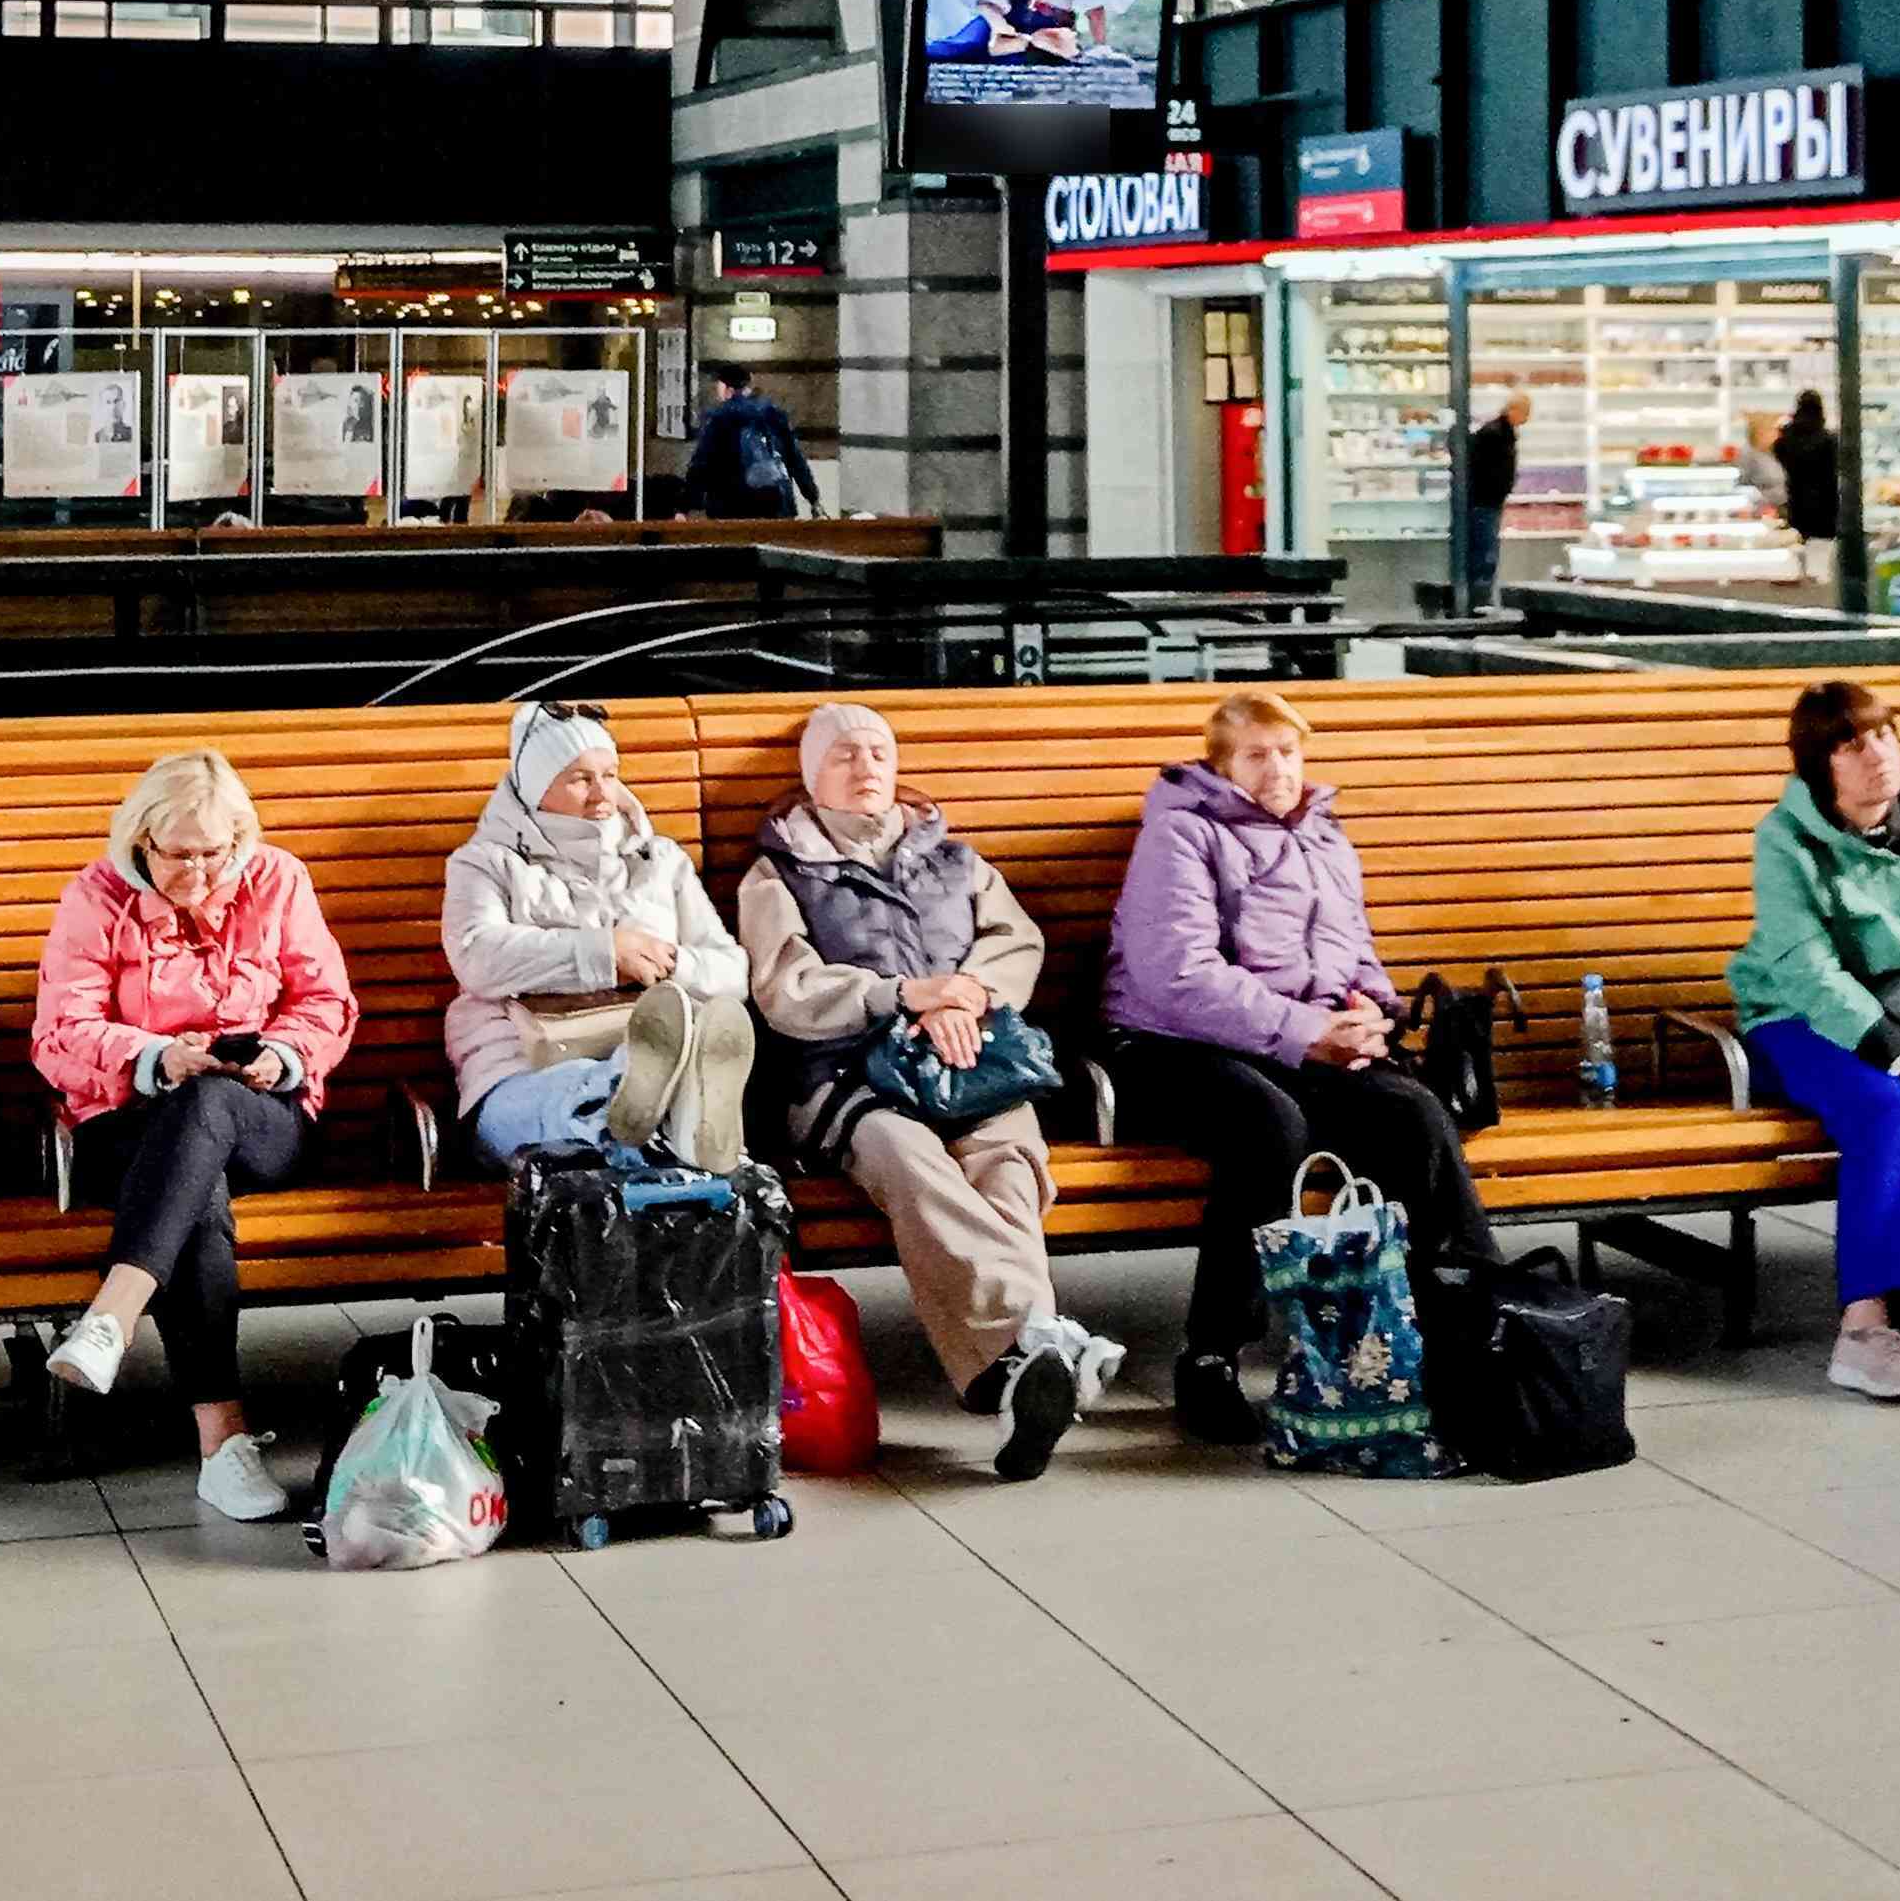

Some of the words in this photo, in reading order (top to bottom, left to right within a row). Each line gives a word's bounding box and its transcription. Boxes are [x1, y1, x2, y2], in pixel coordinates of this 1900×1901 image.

[1167, 100, 1197, 125] 24
[1556, 81, 1848, 199] СУВЕНИРЫ
[1046, 172, 1199, 244] СТОЛОВАЯ
[767, 240, 795, 265] 12
